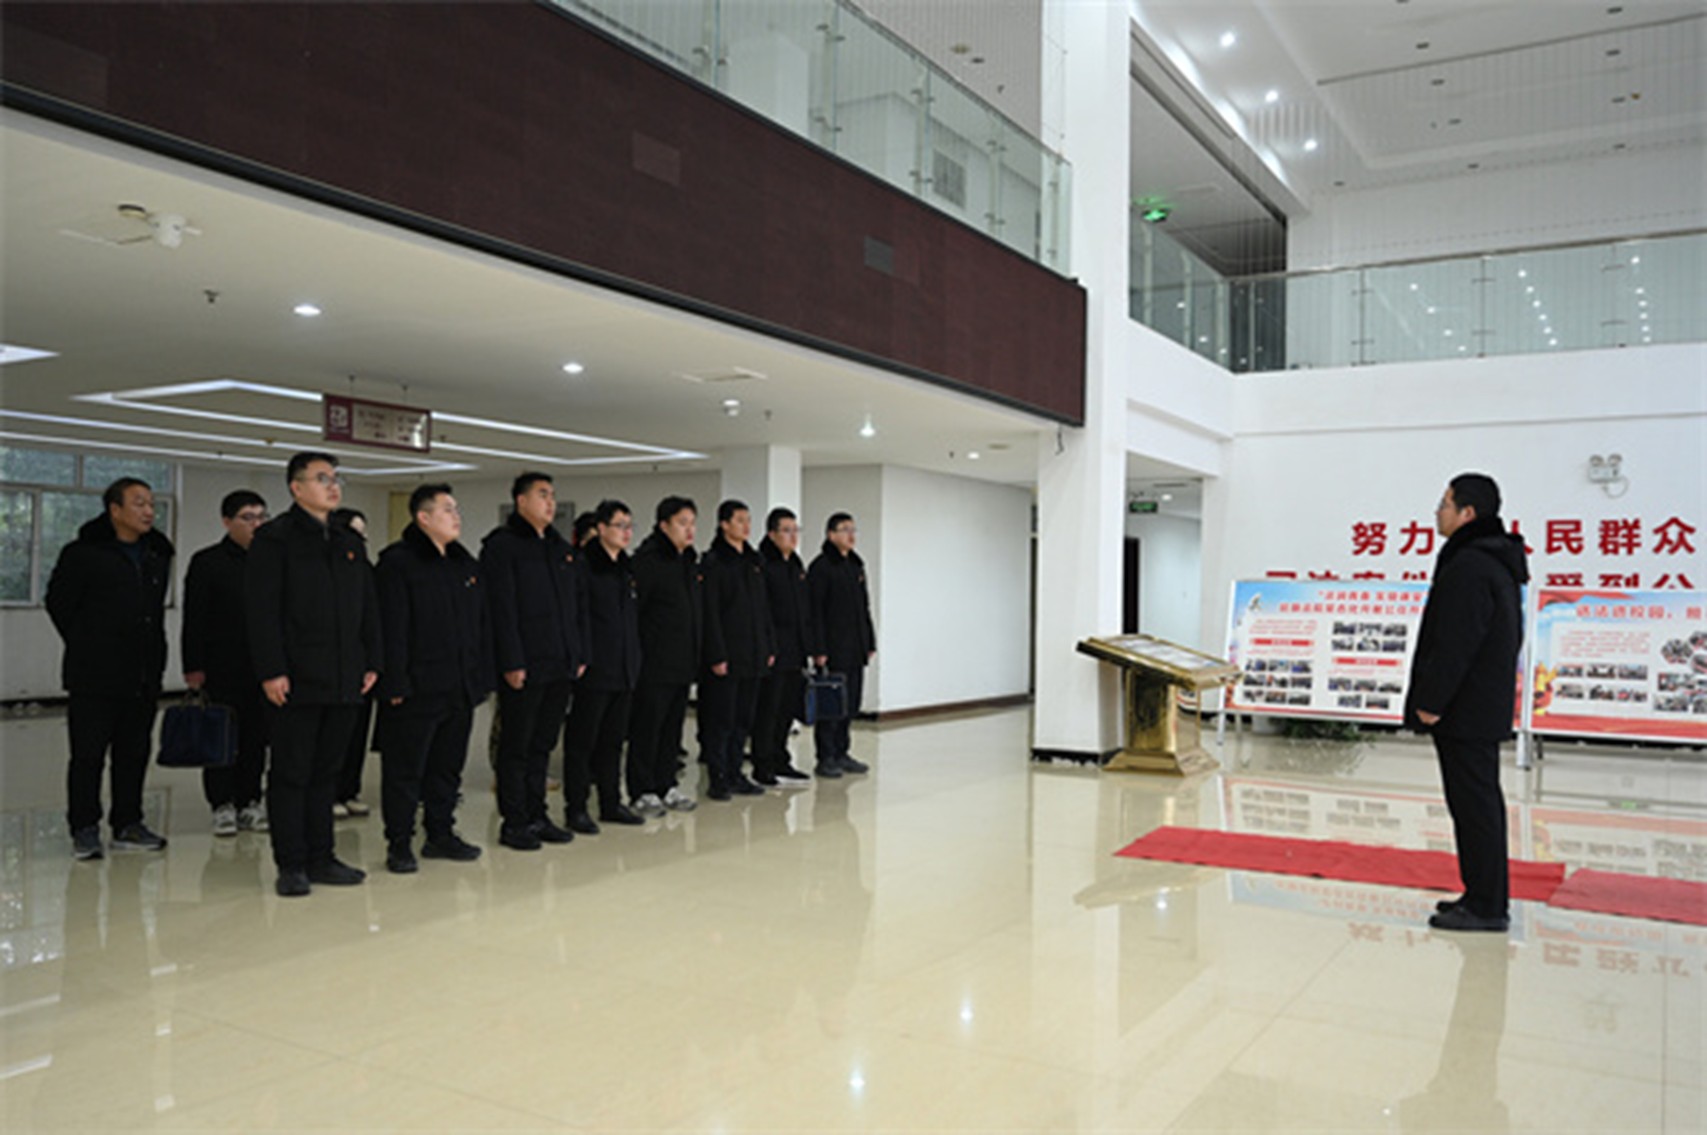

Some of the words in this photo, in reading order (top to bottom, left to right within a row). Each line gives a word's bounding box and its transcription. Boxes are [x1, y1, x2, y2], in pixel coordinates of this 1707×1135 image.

[1352, 516, 1696, 556] 努力民群众
